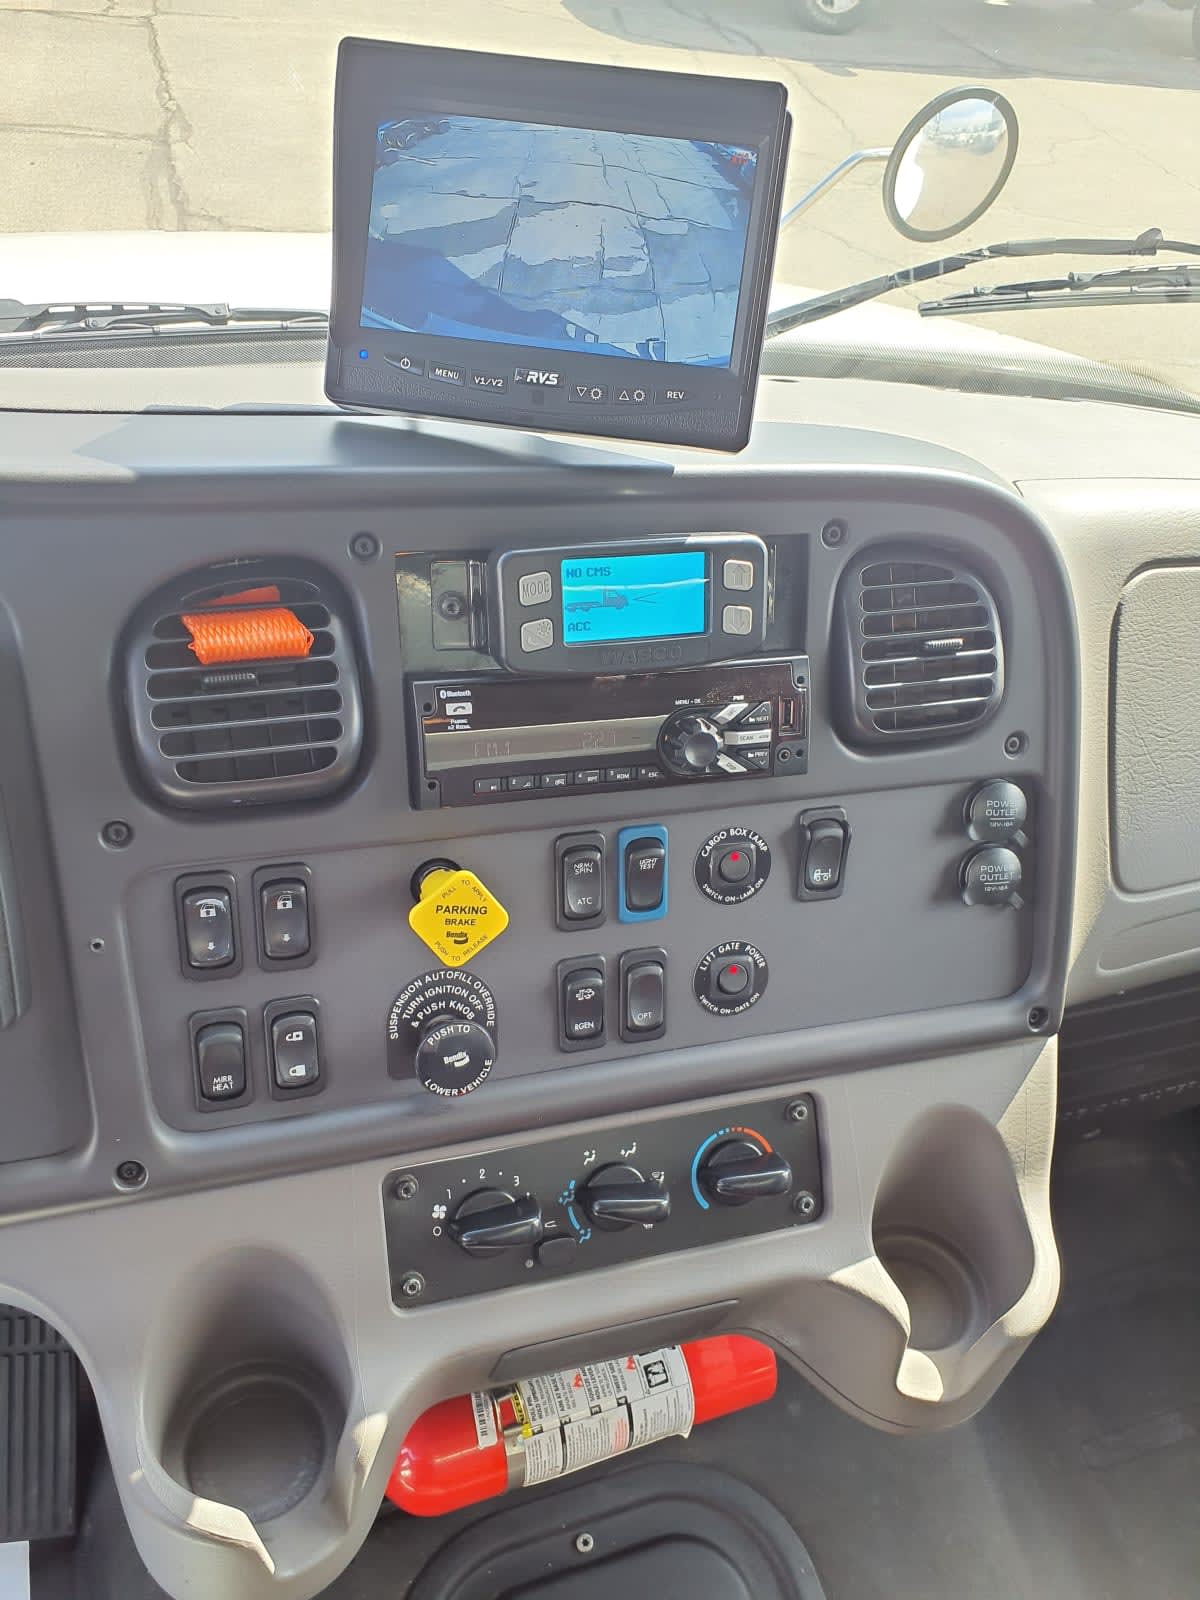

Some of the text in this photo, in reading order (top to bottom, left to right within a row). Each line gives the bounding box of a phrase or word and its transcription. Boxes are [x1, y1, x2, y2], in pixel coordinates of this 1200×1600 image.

[435, 368, 460, 379] MENU
[526, 371, 560, 385] RVS
[474, 376, 504, 387] V1/V2
[666, 390, 685, 400] REV
[566, 566, 612, 578] NO CMS
[522, 578, 549, 598] MODE
[702, 828, 768, 857] CARGO BOX LAMP
[980, 865, 1014, 873] POWE
[578, 897, 592, 905] ATC
[435, 905, 488, 915] PARKING
[700, 942, 766, 971] LIFT GATE POWER
[388, 970, 495, 1039] SUSPENSION AUTOFILL OVERRIDE
[402, 985, 483, 1020] TURN IGNITION OFF
[417, 1001, 446, 1019] PUSH
[449, 1000, 475, 1020] KNOB
[637, 1012, 652, 1020] OPT
[575, 1022, 594, 1031] RGEN
[427, 1024, 470, 1046] PUSH TO
[213, 1075, 233, 1083] MIRR
[424, 1059, 492, 1096] LOWER VEHICLE
[212, 1082, 233, 1092] HEAT
[479, 1168, 486, 1179] 2
[514, 1175, 520, 1186] 3
[446, 1189, 452, 1200] 1
